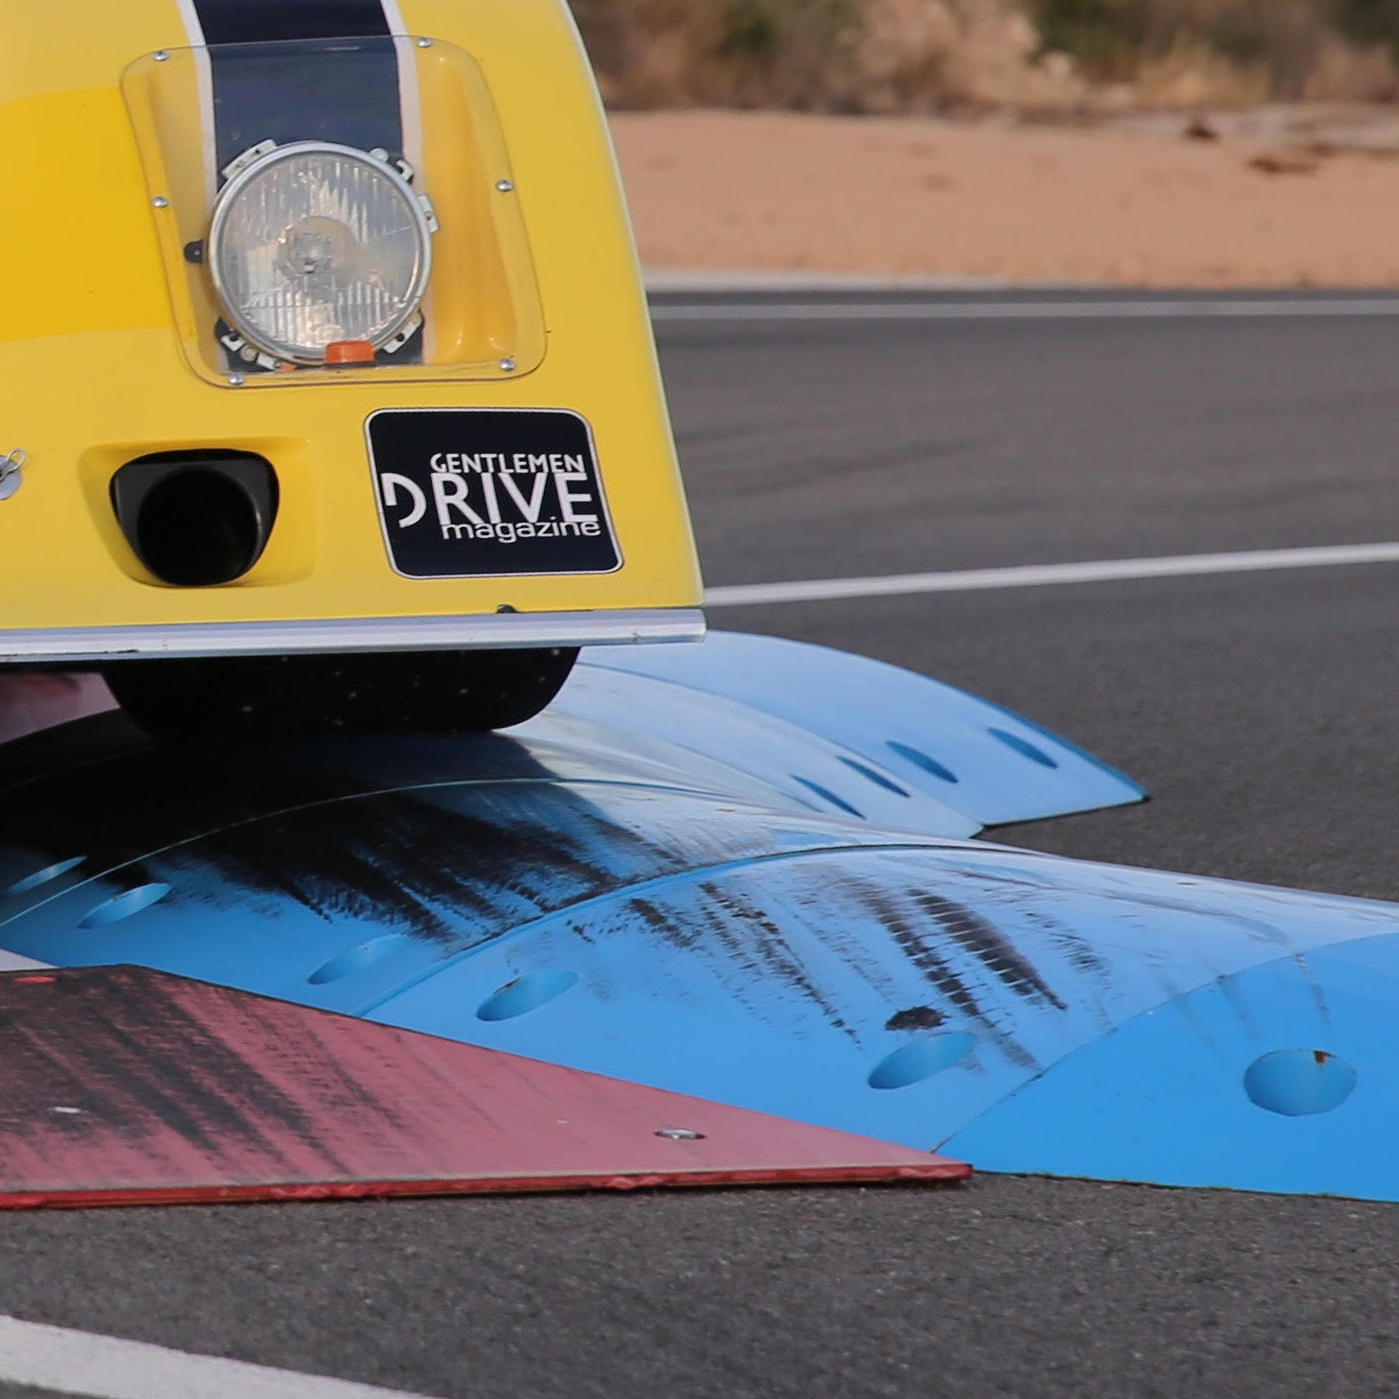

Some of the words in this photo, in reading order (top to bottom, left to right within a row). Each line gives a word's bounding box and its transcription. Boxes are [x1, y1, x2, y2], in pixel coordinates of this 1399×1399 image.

[430, 452, 585, 474] GENTLEMEN
[380, 471, 599, 529] DRIVE
[441, 516, 602, 544] magazine
